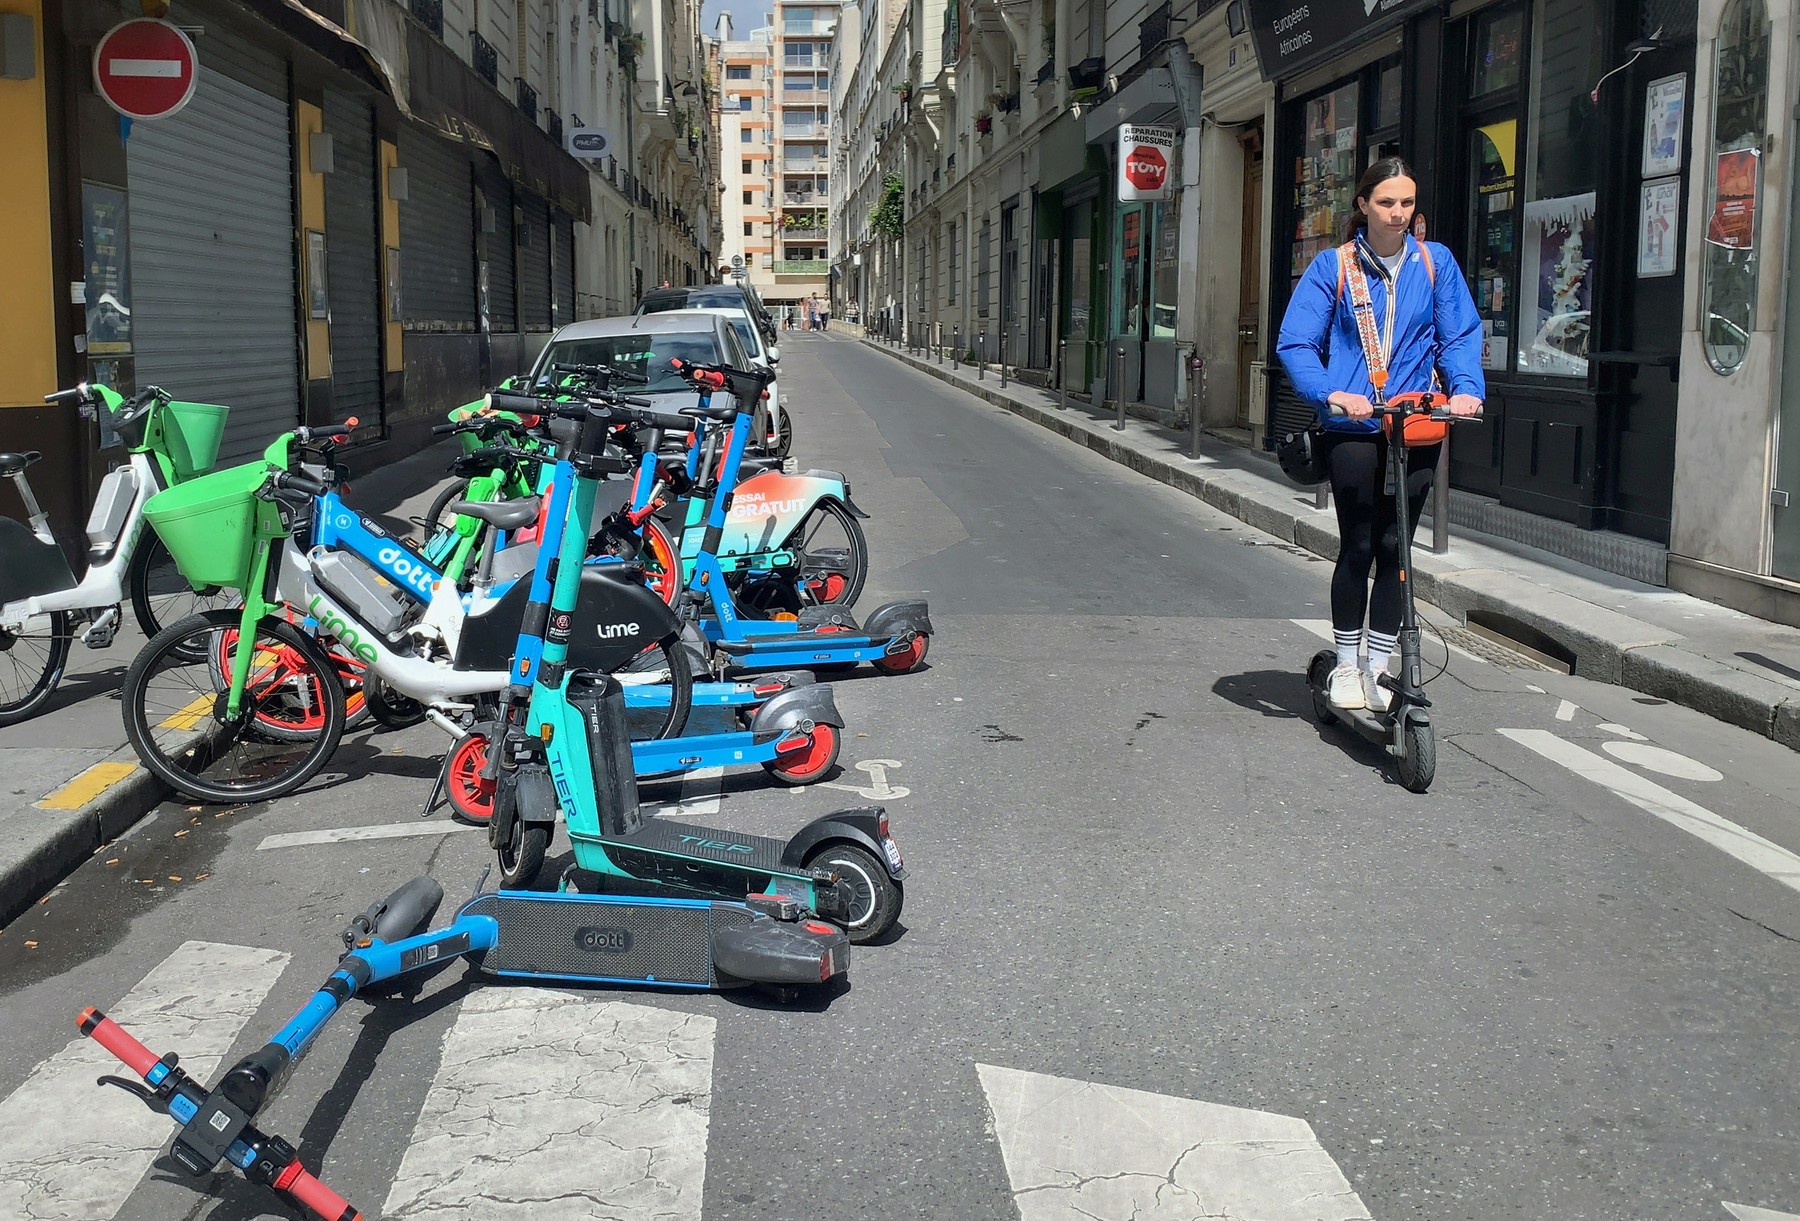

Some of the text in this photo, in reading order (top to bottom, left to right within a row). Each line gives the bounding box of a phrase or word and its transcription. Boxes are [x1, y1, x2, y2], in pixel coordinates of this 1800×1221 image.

[1272, 4, 1310, 36] Européens
[1279, 30, 1313, 57] Africaines
[576, 139, 591, 147] PMU
[1123, 136, 1173, 147] CHAUSSURES
[1124, 128, 1173, 139] REPARATION
[732, 492, 766, 504] ESSAI
[732, 498, 807, 518] GRATUIT
[378, 547, 433, 593] dott
[721, 602, 734, 623] dott
[308, 594, 379, 664] Lime
[596, 622, 640, 639] Lime
[590, 703, 600, 734] TIER
[551, 750, 577, 819] TIER
[679, 834, 754, 854] TIER
[584, 930, 624, 949] dott
